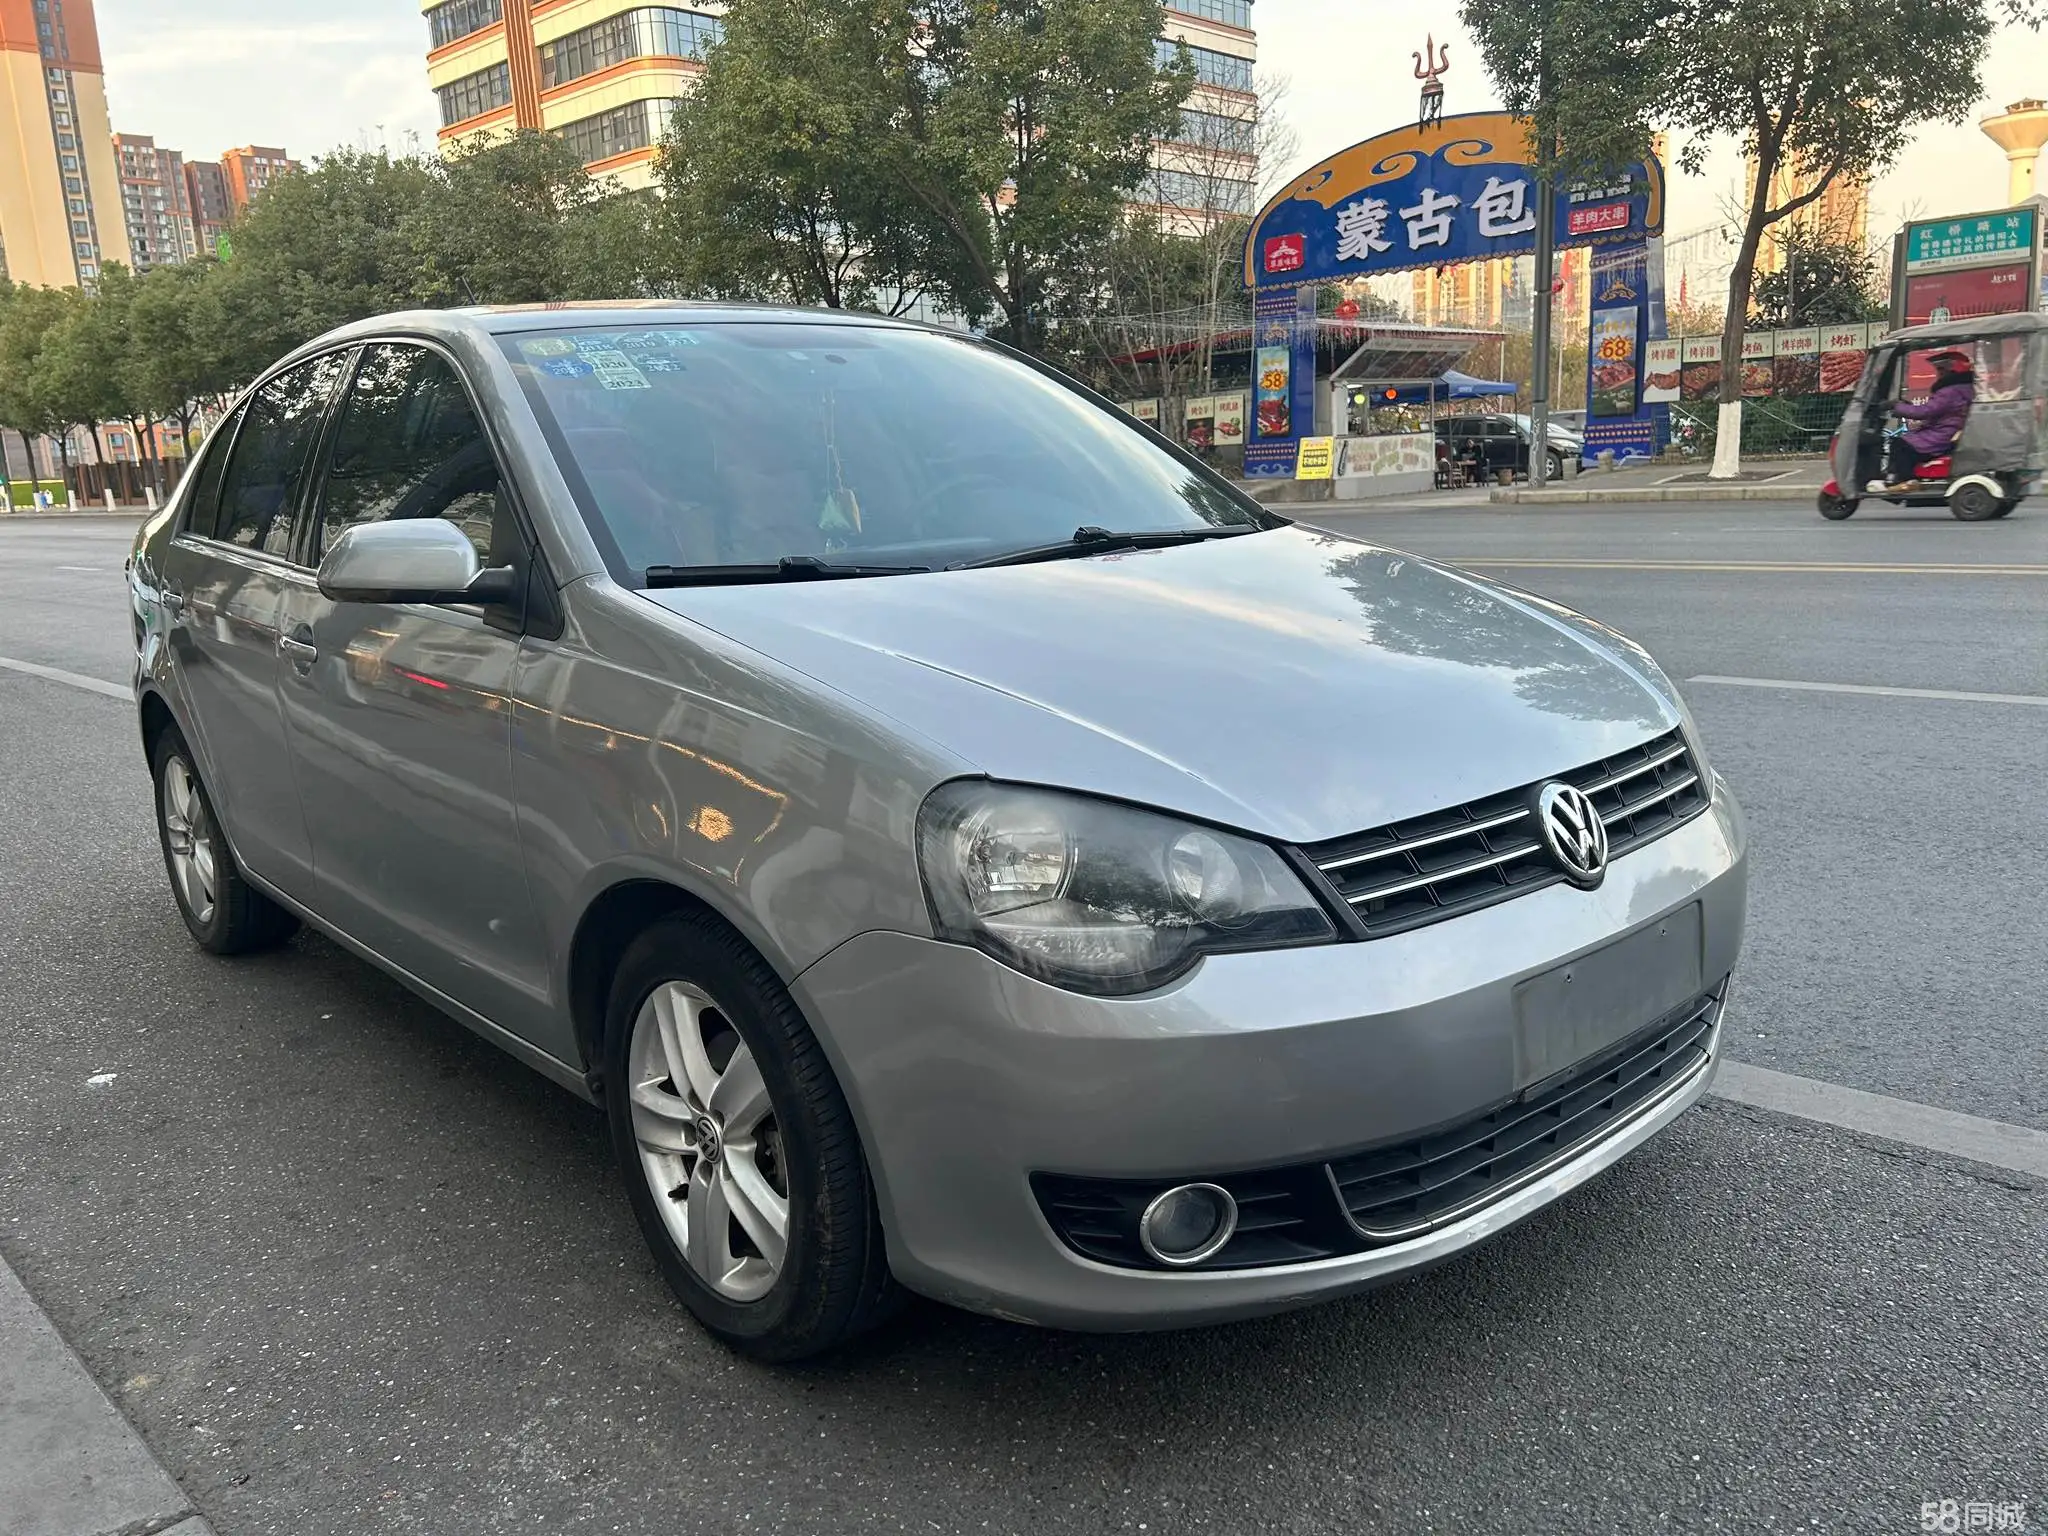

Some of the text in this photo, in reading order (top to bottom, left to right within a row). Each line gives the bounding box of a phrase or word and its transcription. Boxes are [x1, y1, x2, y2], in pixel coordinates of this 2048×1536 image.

[1336, 177, 1536, 262] 蒙古包
[1572, 206, 1625, 226] 羊肉大串
[1603, 341, 1626, 358] 68
[1830, 333, 1857, 348] 烤虾
[1264, 373, 1282, 388] 58
[1544, 784, 1605, 877] VW
